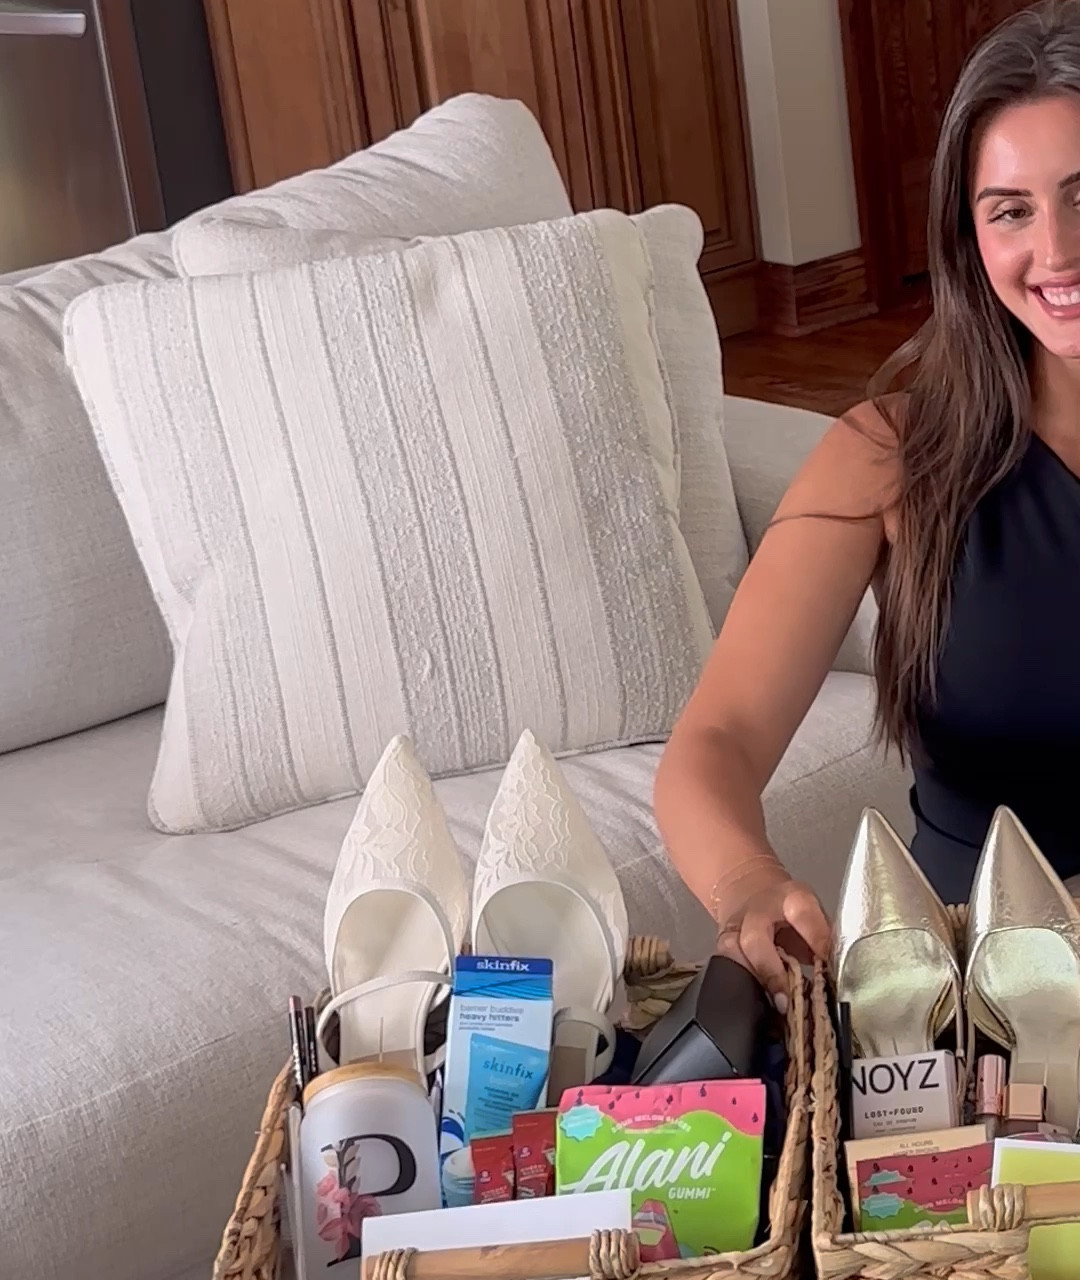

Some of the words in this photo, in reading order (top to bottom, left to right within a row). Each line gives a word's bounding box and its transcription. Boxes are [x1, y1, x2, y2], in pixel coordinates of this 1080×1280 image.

[476, 959, 530, 972] skinfix
[483, 1057, 534, 1080] skinfix
[852, 1058, 940, 1095] NOYZ
[560, 1131, 733, 1194] Alani
[668, 1187, 711, 1200] GUMMI
